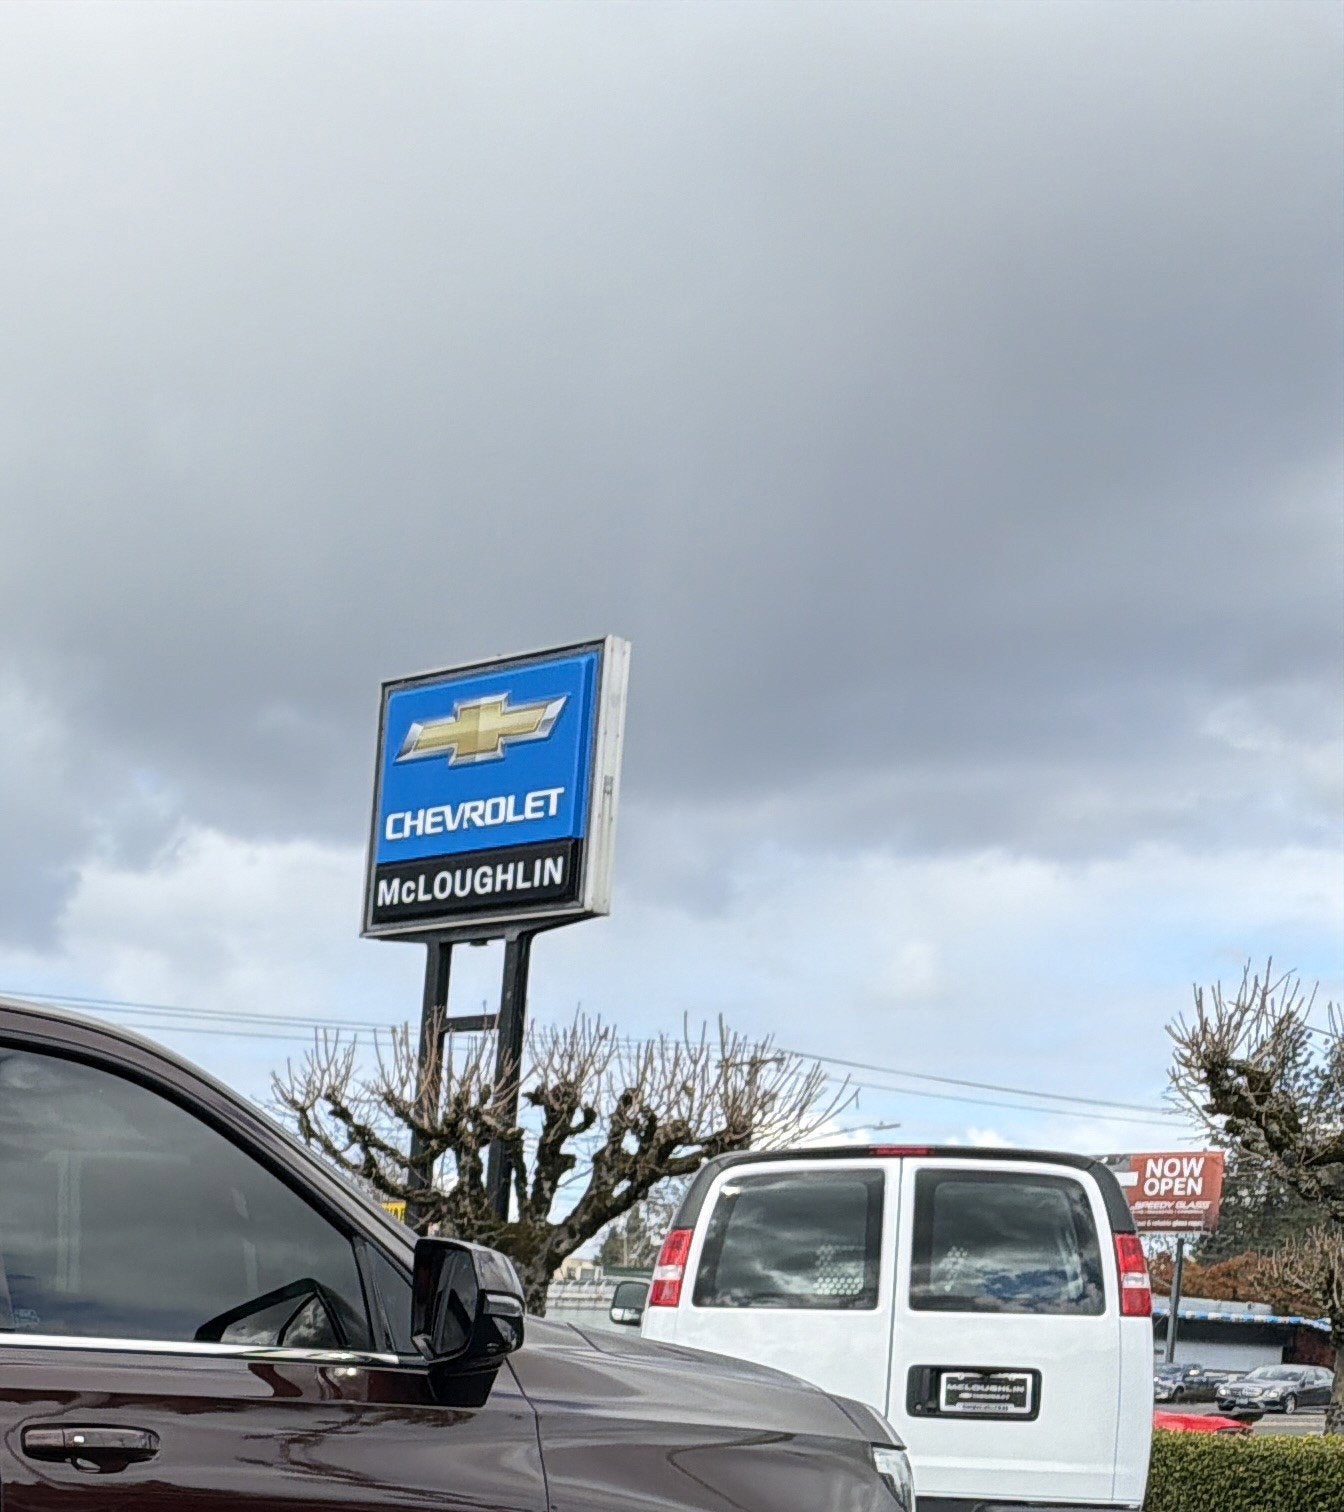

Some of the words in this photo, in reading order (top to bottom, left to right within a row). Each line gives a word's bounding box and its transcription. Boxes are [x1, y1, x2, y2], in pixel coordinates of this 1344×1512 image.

[385, 787, 565, 840] CHEVROLET
[376, 855, 564, 908] McLOUGHLIN
[1145, 1157, 1205, 1178] NOW
[1143, 1177, 1203, 1197] OPEN
